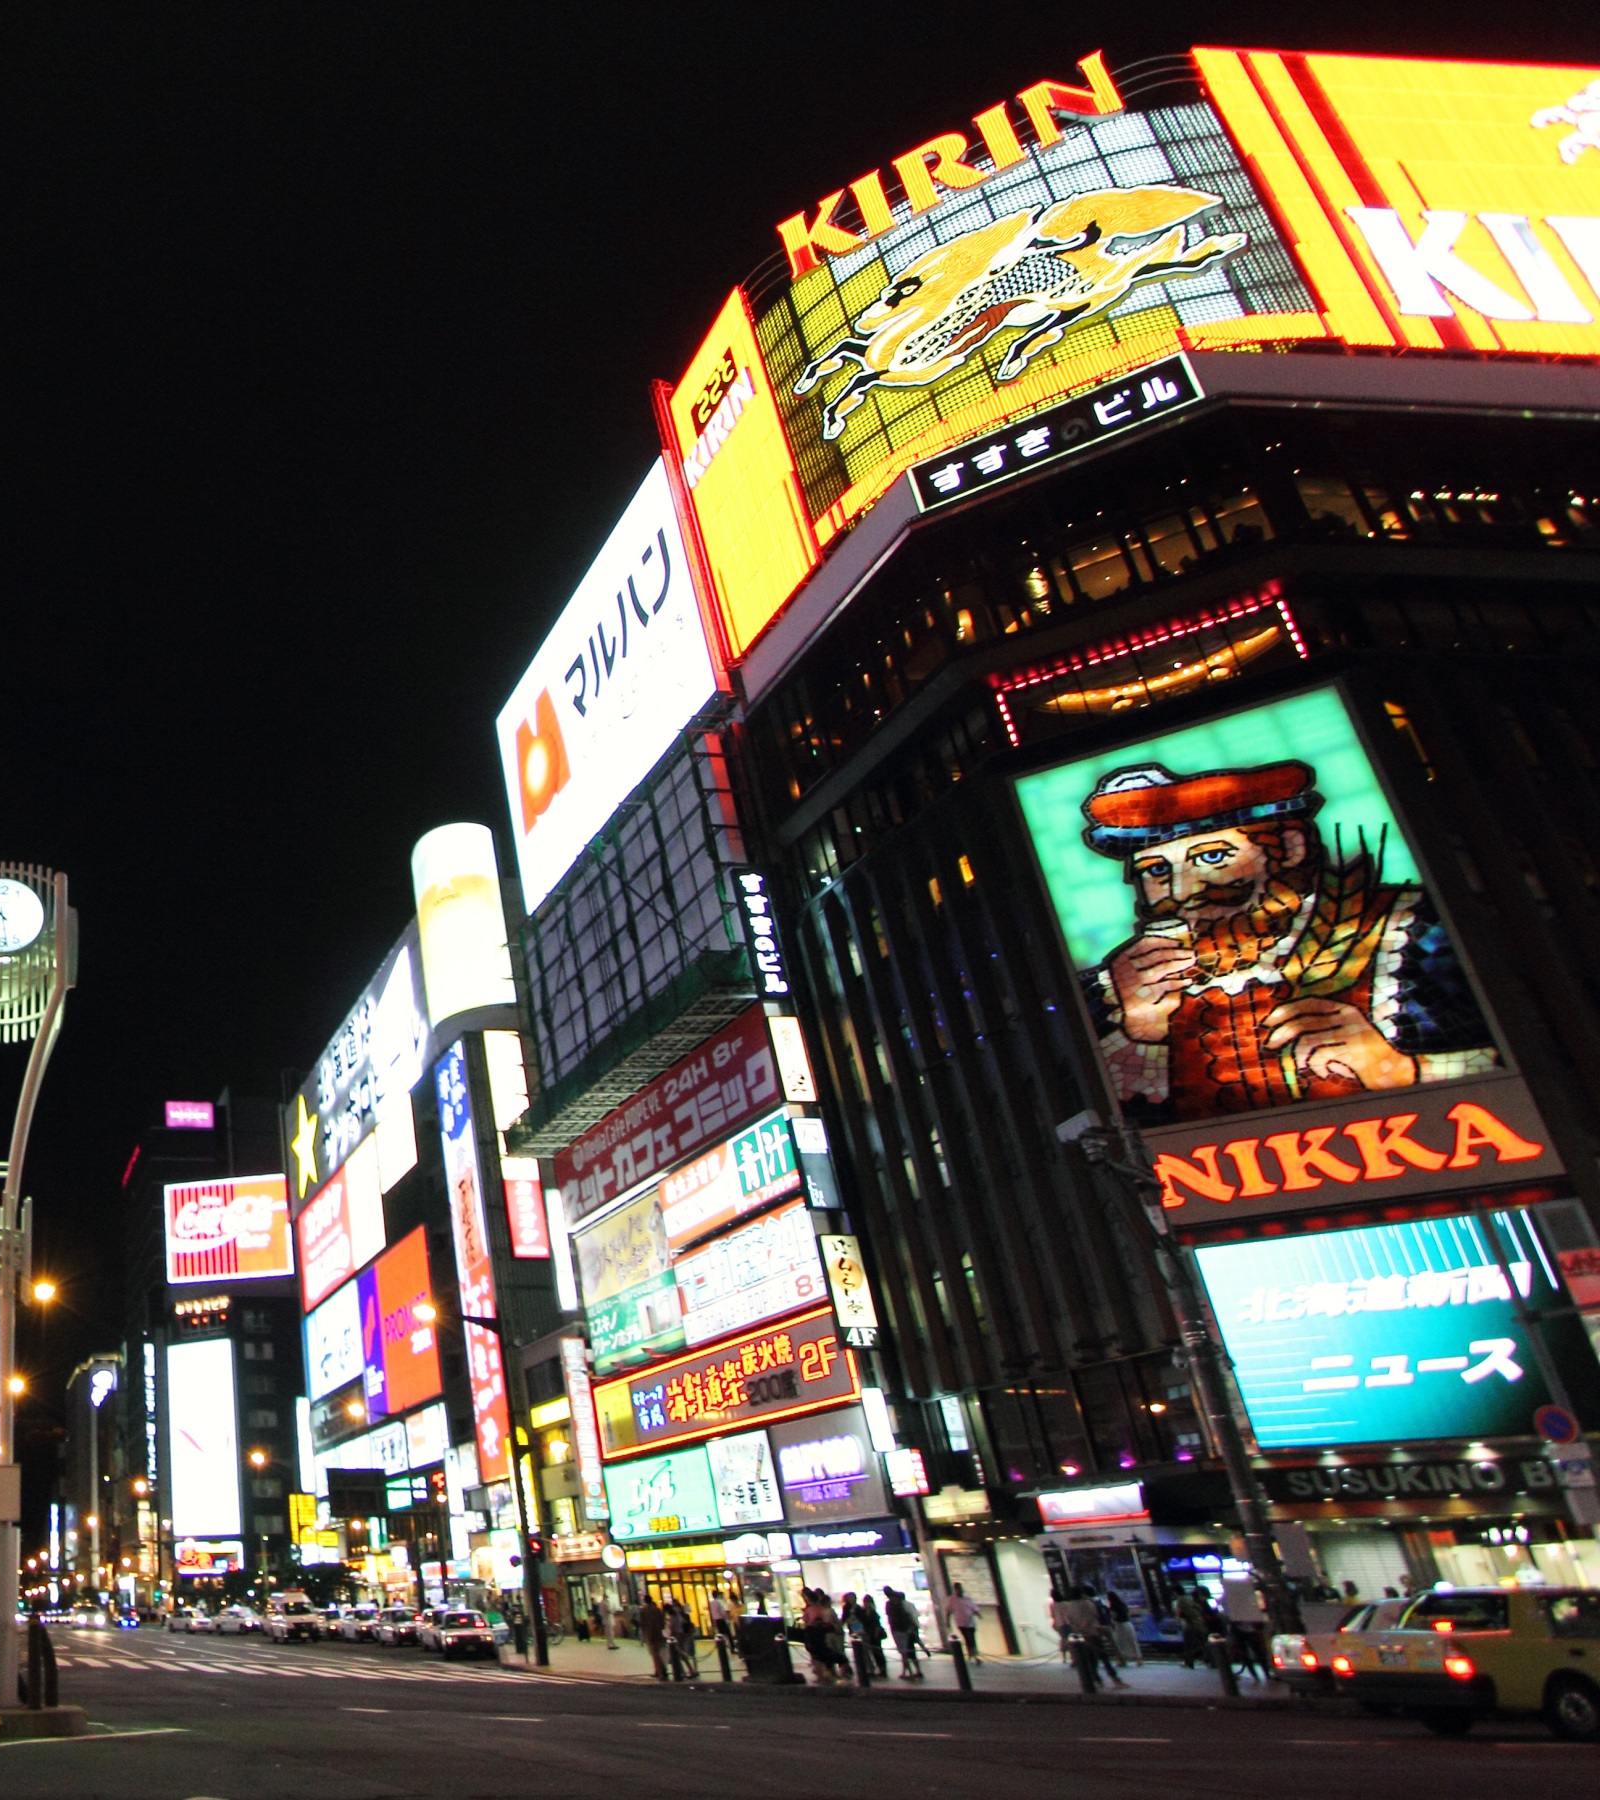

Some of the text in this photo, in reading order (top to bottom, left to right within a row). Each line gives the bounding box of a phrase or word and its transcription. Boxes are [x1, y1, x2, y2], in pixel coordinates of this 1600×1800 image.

[776, 50, 1125, 282] KIRIN
[683, 368, 756, 490] KIRIN
[929, 376, 1178, 493] すすきのビル
[564, 527, 672, 718] マルハン
[663, 1056, 709, 1105] 24H
[712, 1036, 744, 1068] 8F
[738, 1122, 791, 1192] 青汁
[1153, 1102, 1544, 1209] NIKKA
[739, 1334, 794, 1376] 炭火焼
[798, 1336, 838, 1382] 2F
[846, 1327, 877, 1347] 4F
[1301, 1337, 1525, 1393] ニュース
[1287, 1460, 1505, 1496] SUSUKINO
